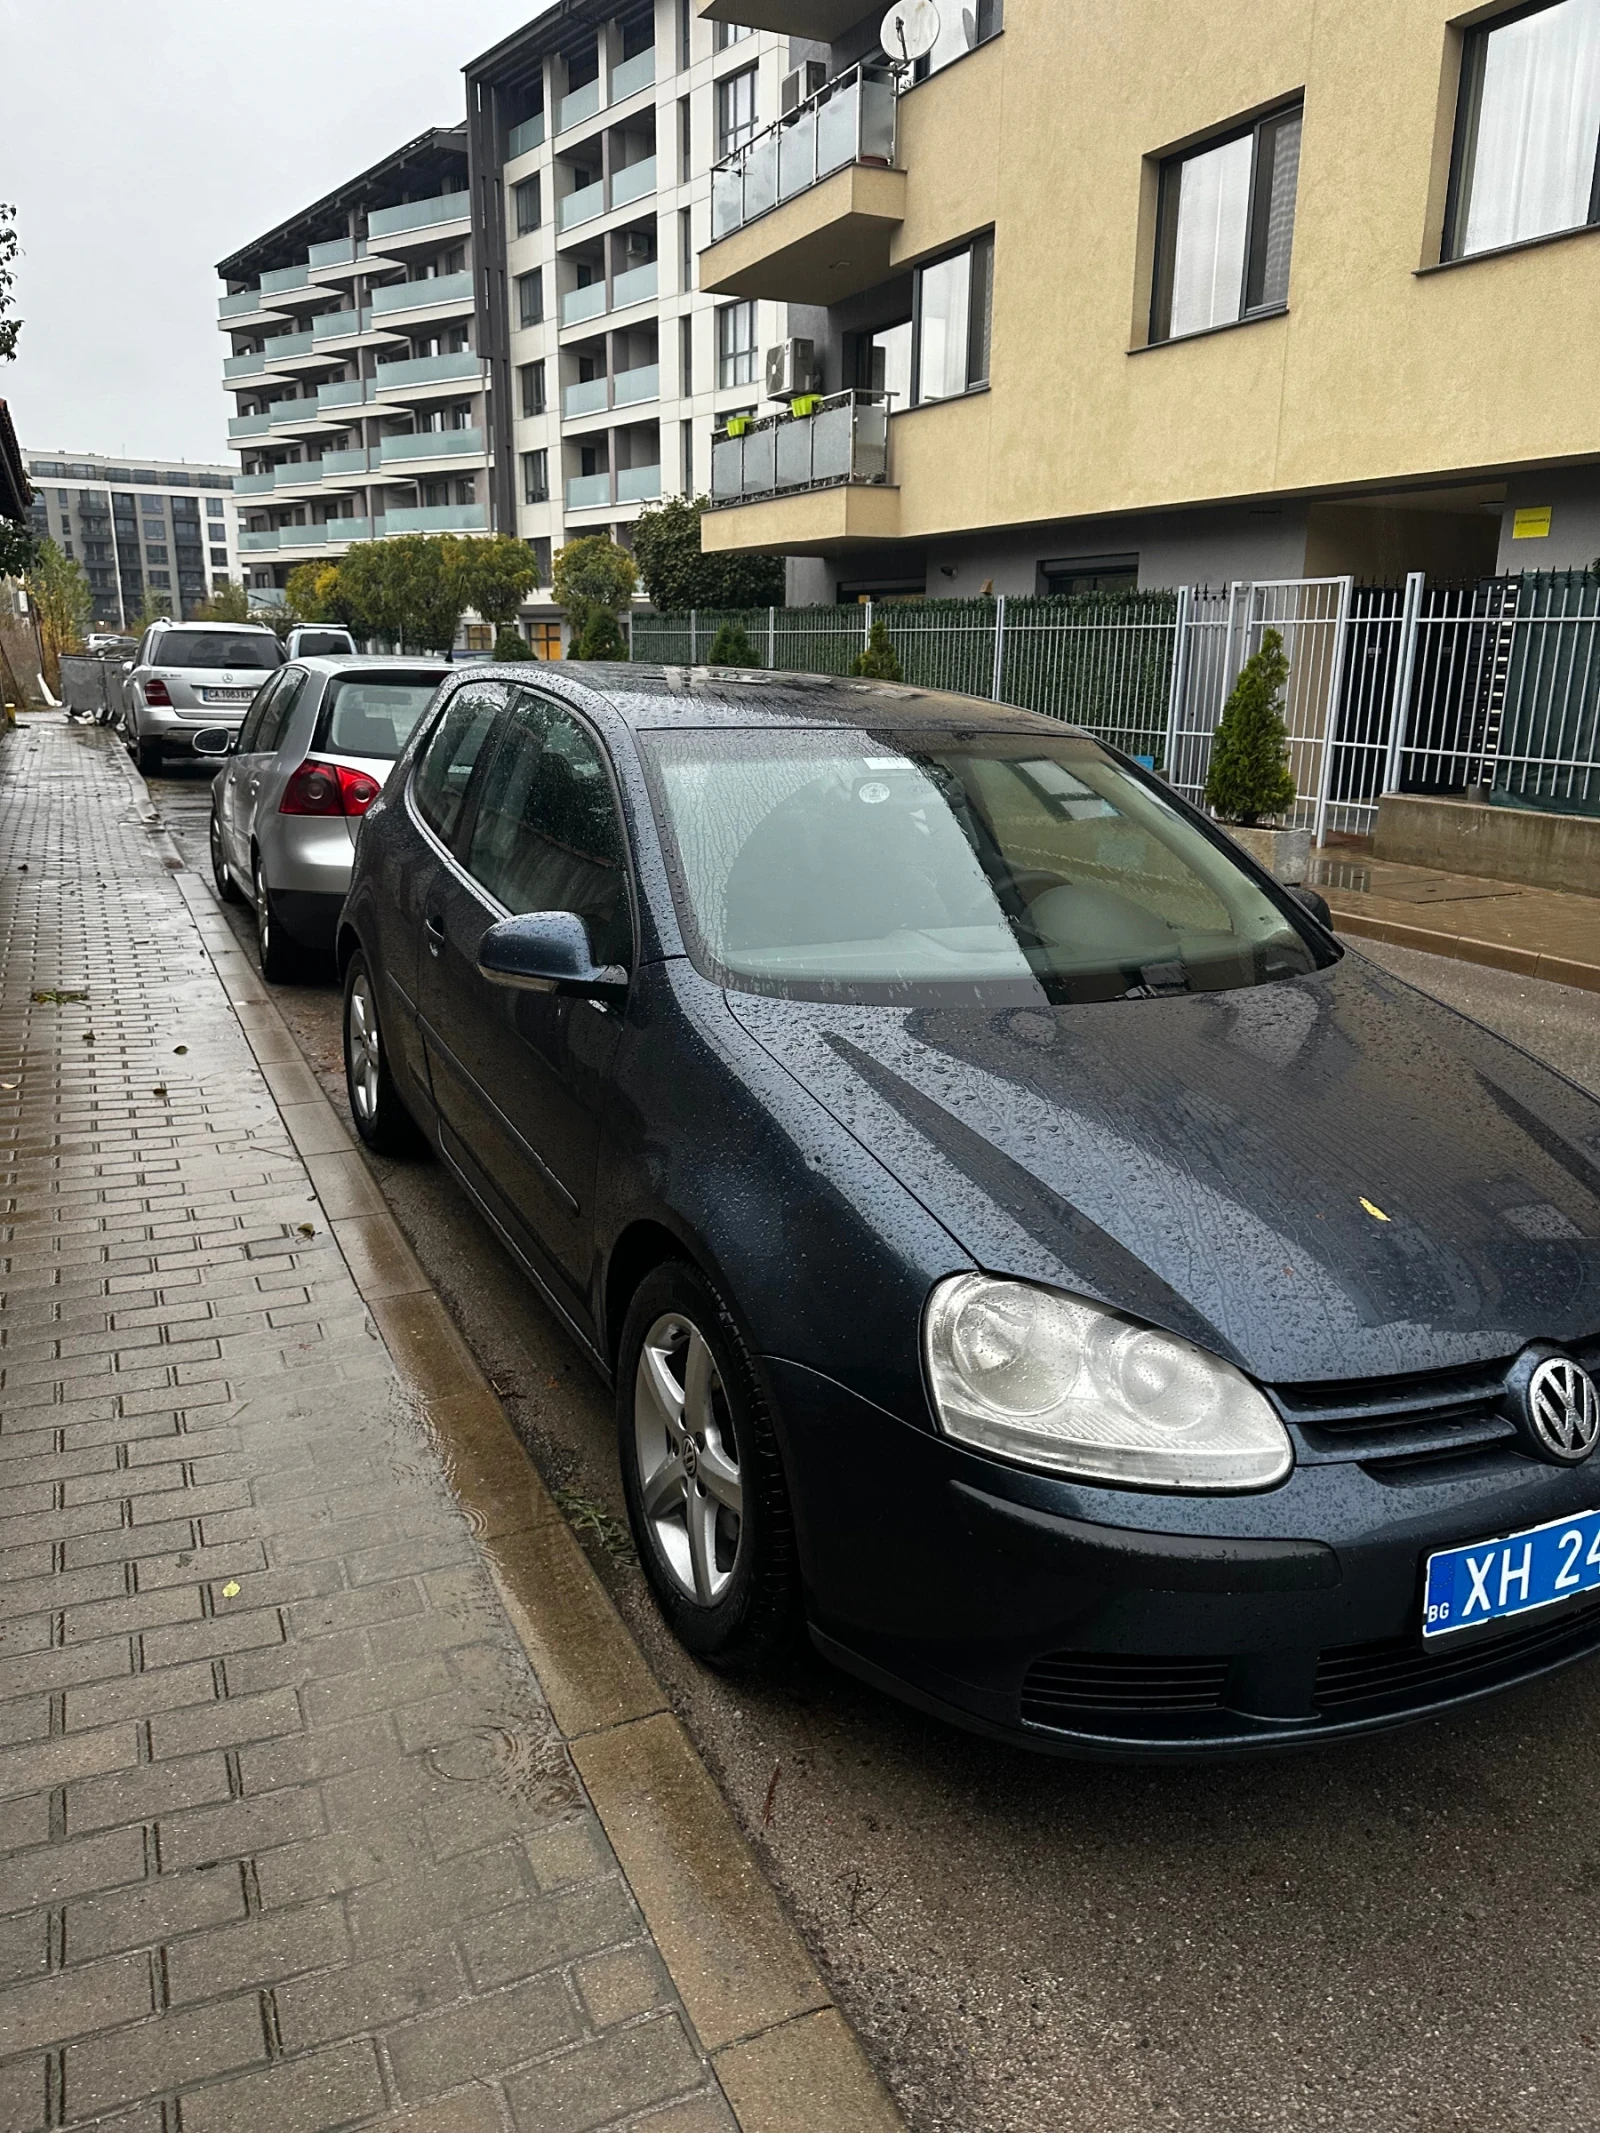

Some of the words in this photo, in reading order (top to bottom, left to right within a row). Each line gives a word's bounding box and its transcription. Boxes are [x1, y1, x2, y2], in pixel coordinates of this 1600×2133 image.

[208, 689, 219, 698] CA
[1461, 1542, 1533, 1617] XH
[1428, 1602, 1450, 1623] BG
